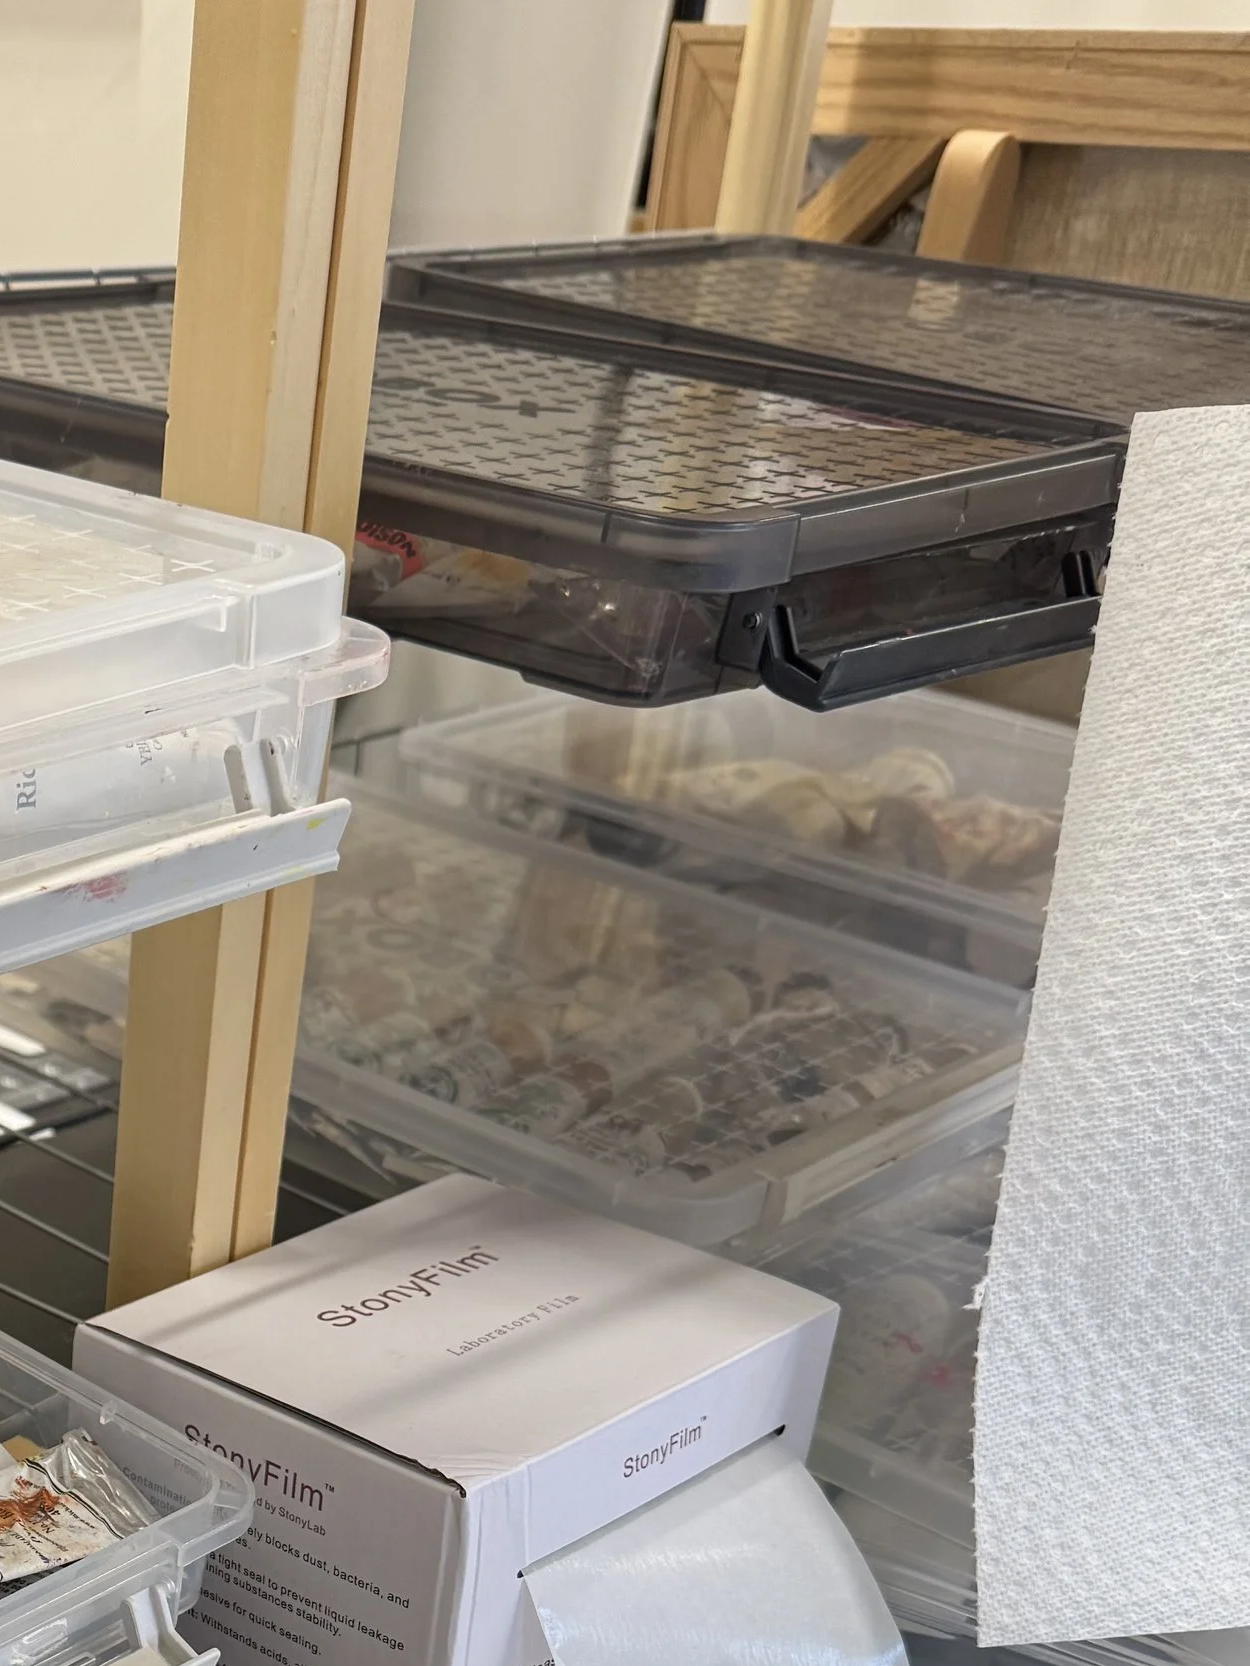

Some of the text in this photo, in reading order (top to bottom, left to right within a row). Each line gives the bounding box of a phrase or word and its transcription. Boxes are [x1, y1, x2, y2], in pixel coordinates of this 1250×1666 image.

[446, 1293, 581, 1357] Laboratory Film
[264, 1500, 276, 1516] by
[278, 1503, 327, 1537] StonyLab
[264, 1530, 301, 1559] blocks
[302, 1552, 331, 1574] dust,
[333, 1565, 385, 1600] bacteria,
[386, 1592, 410, 1609] and
[200, 1614, 258, 1651] Withstands
[218, 1553, 242, 1575] tight
[243, 1567, 265, 1587] seal
[267, 1575, 278, 1590] to
[280, 1585, 323, 1613] prevent
[324, 1604, 356, 1629] liquid
[356, 1619, 405, 1652] leakage
[232, 1600, 323, 1657] for quick sealing.
[233, 1576, 343, 1638] substances stability.
